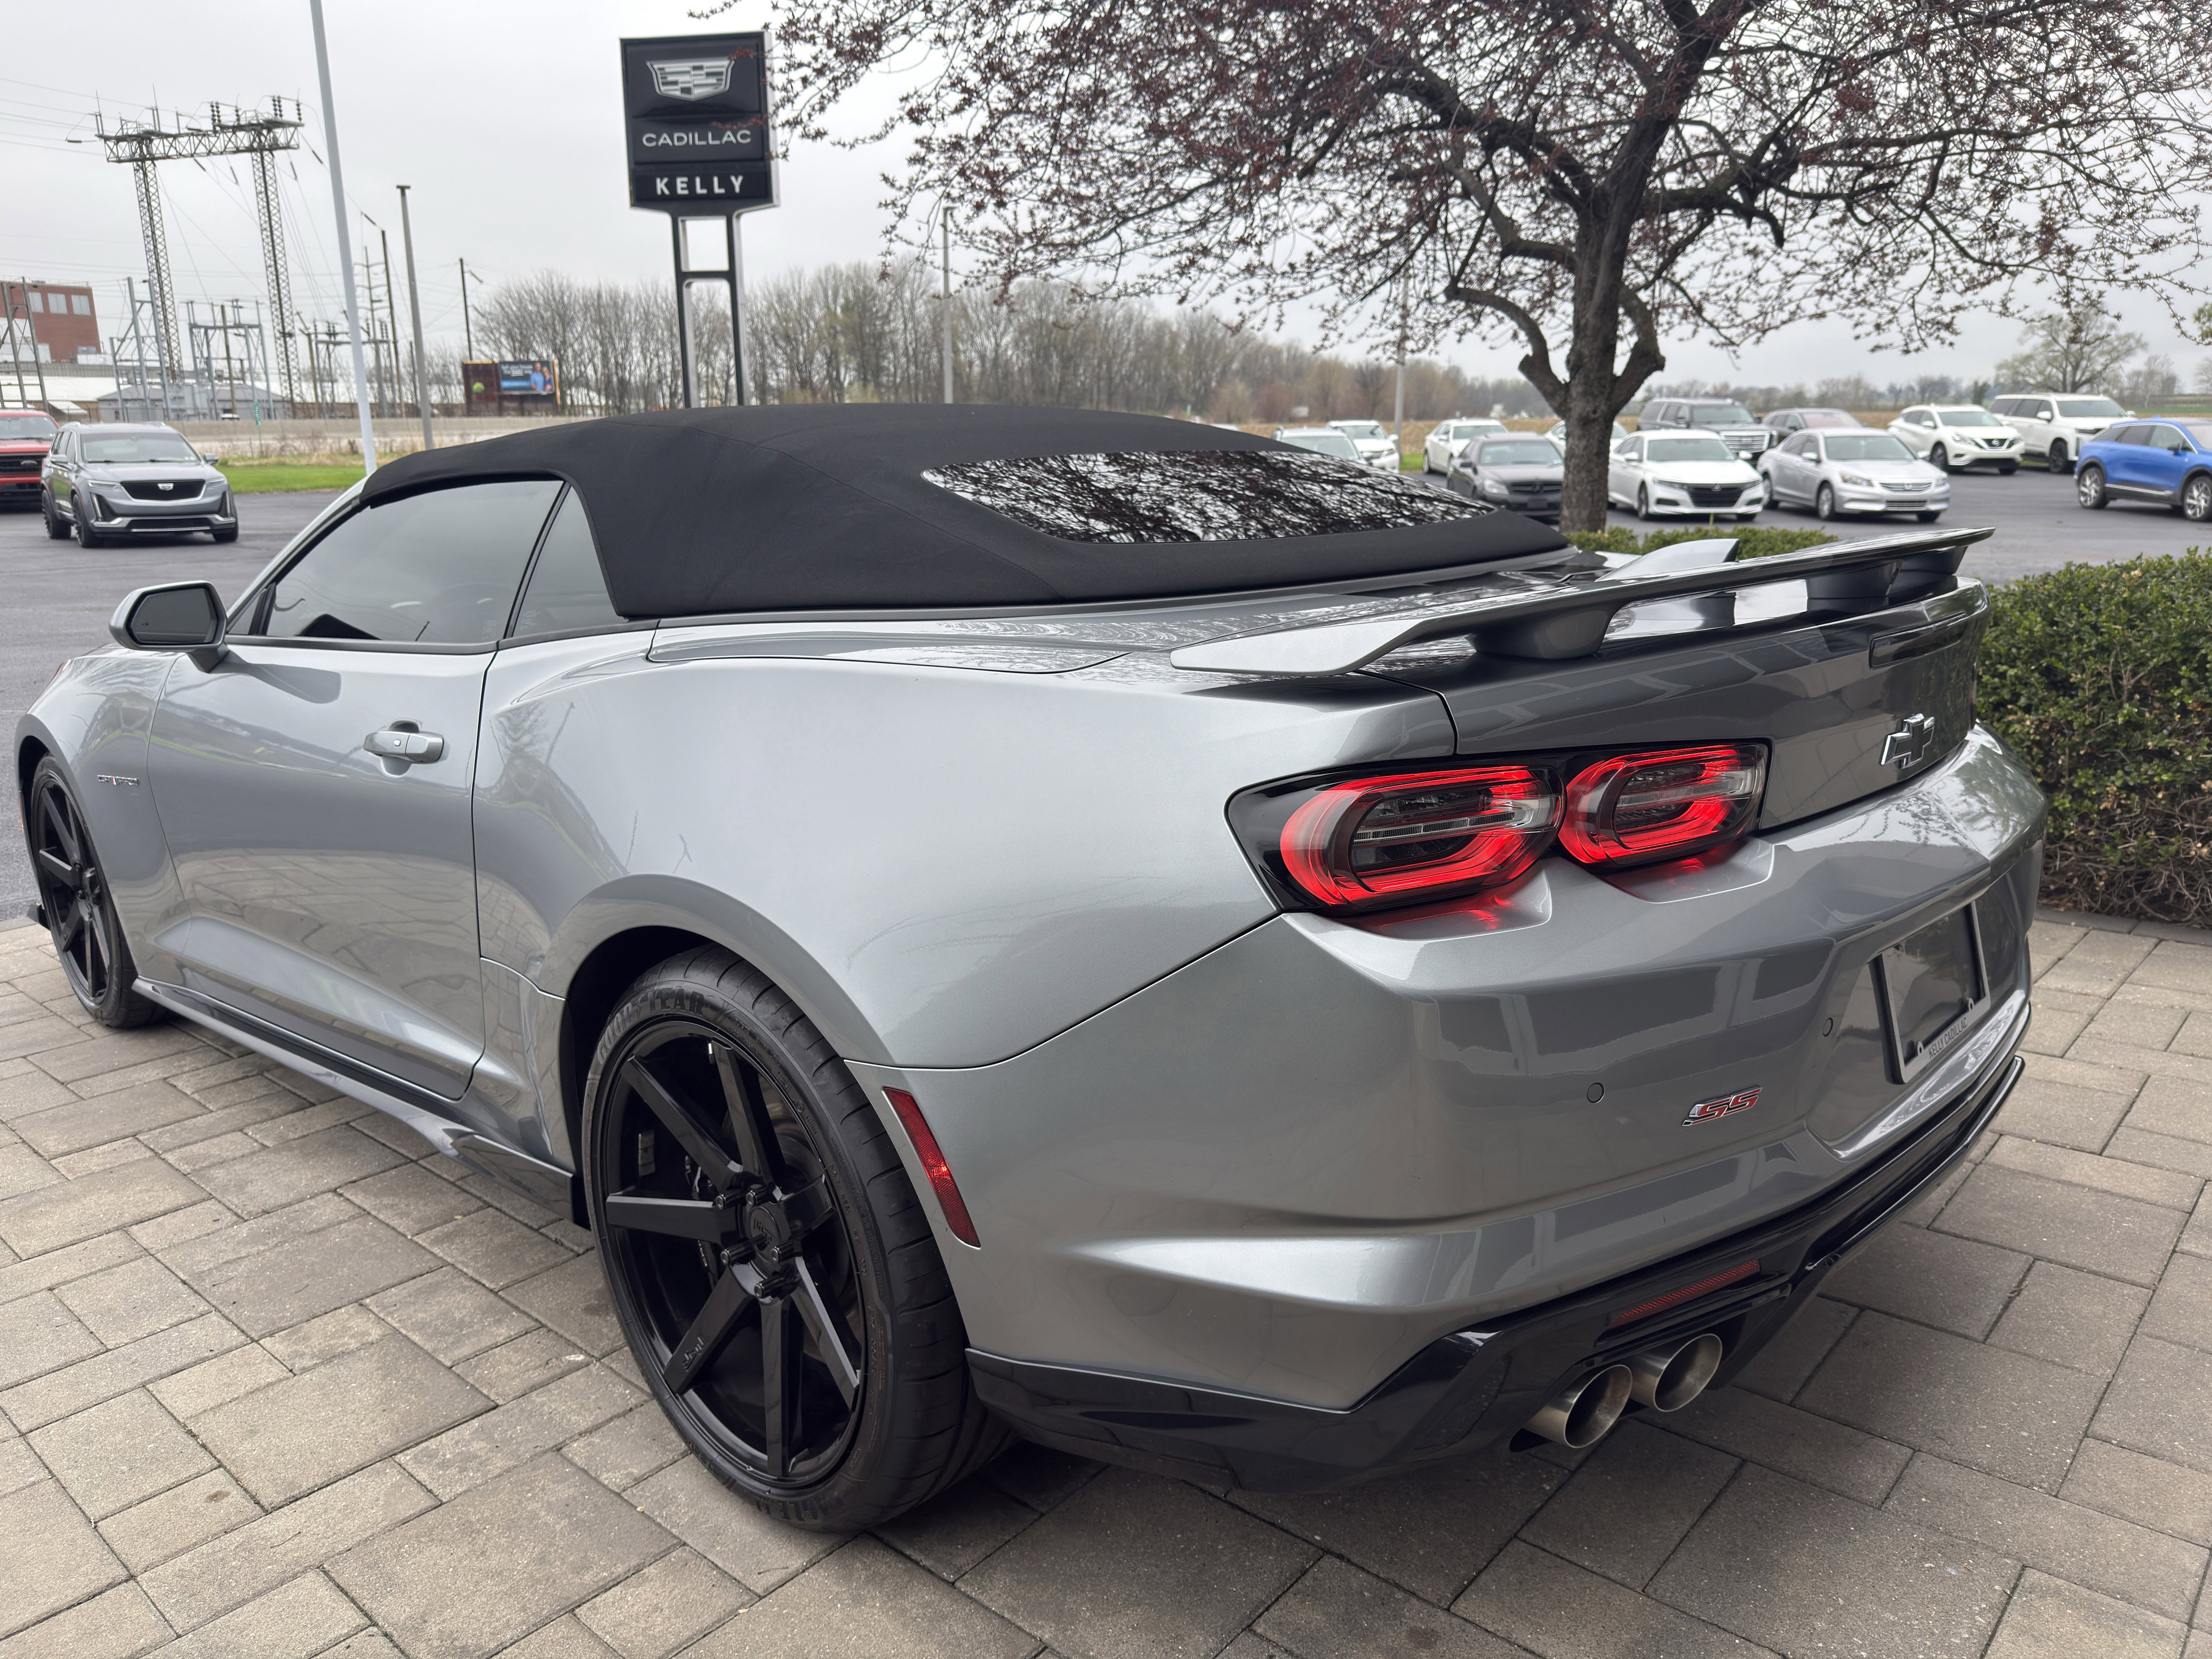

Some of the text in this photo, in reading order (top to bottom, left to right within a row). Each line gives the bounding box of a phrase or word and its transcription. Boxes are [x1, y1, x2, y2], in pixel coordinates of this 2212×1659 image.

[642, 130, 752, 147] CADILLAC
[656, 175, 743, 195] KELLY
[1929, 1017, 1967, 1059] KELLY CADILLAC
[1682, 1086, 1763, 1126] SS
